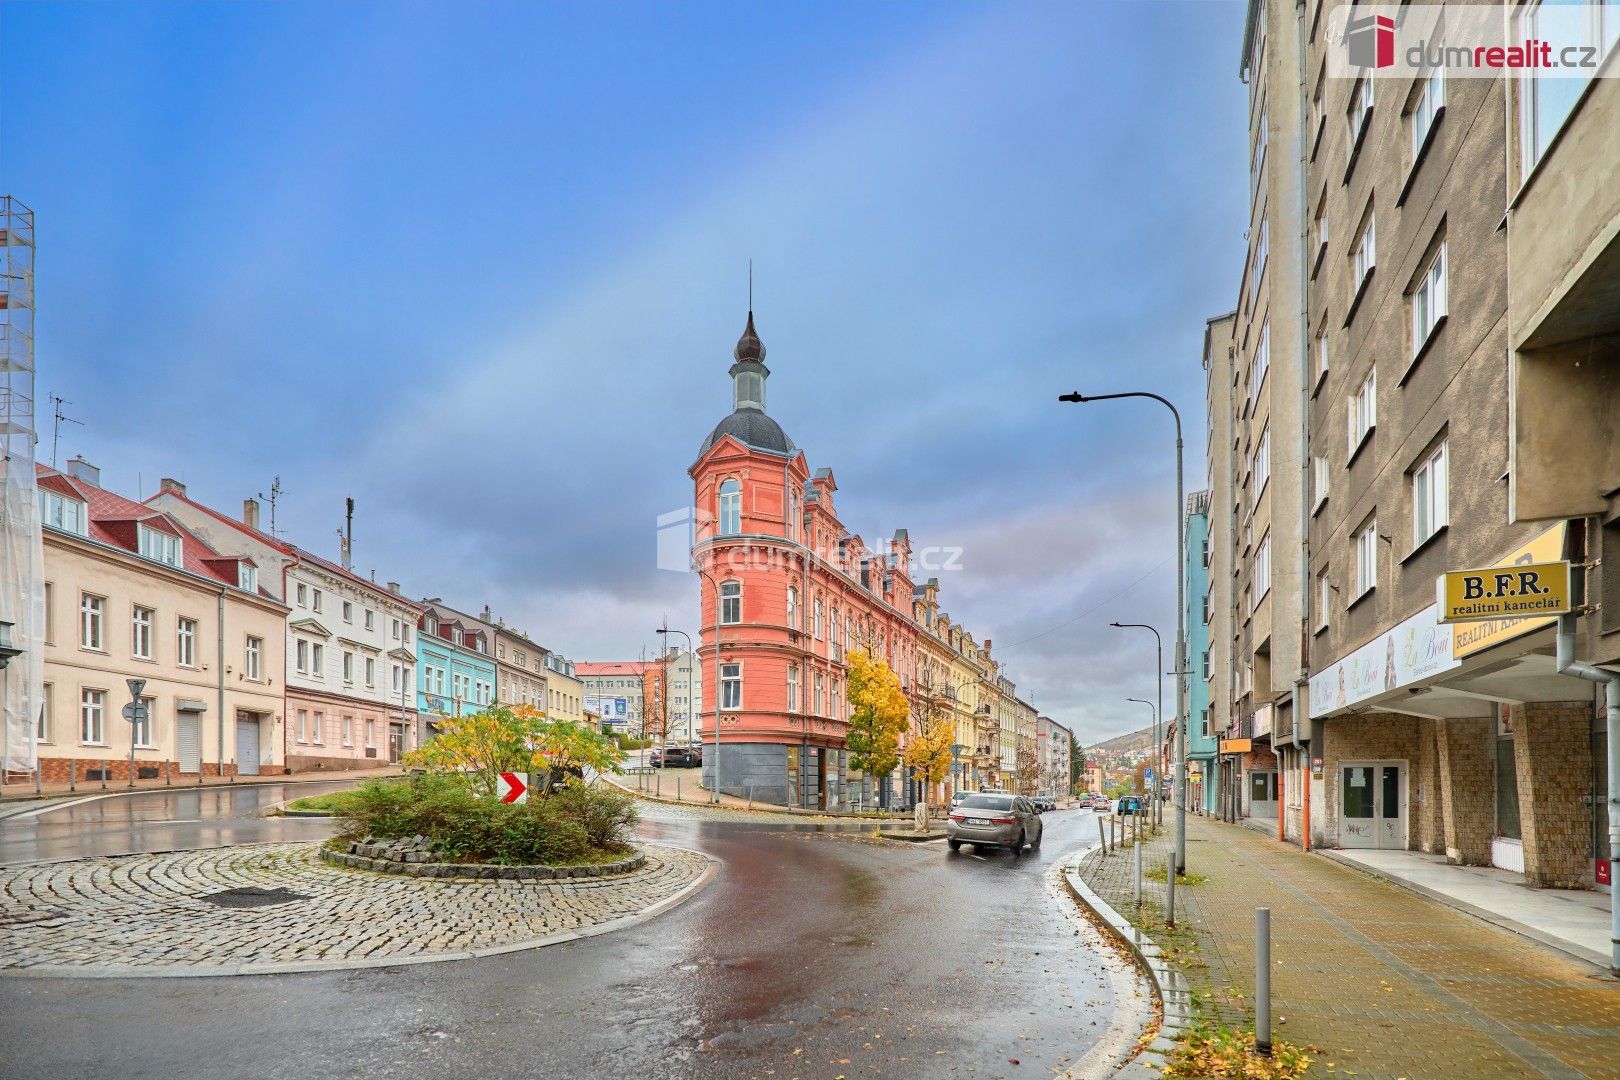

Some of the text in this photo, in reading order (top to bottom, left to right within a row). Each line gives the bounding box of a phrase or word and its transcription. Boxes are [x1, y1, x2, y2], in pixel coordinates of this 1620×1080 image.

[1463, 571, 1550, 600] B.F.R.
[1452, 597, 1561, 615] realitní kancelář
